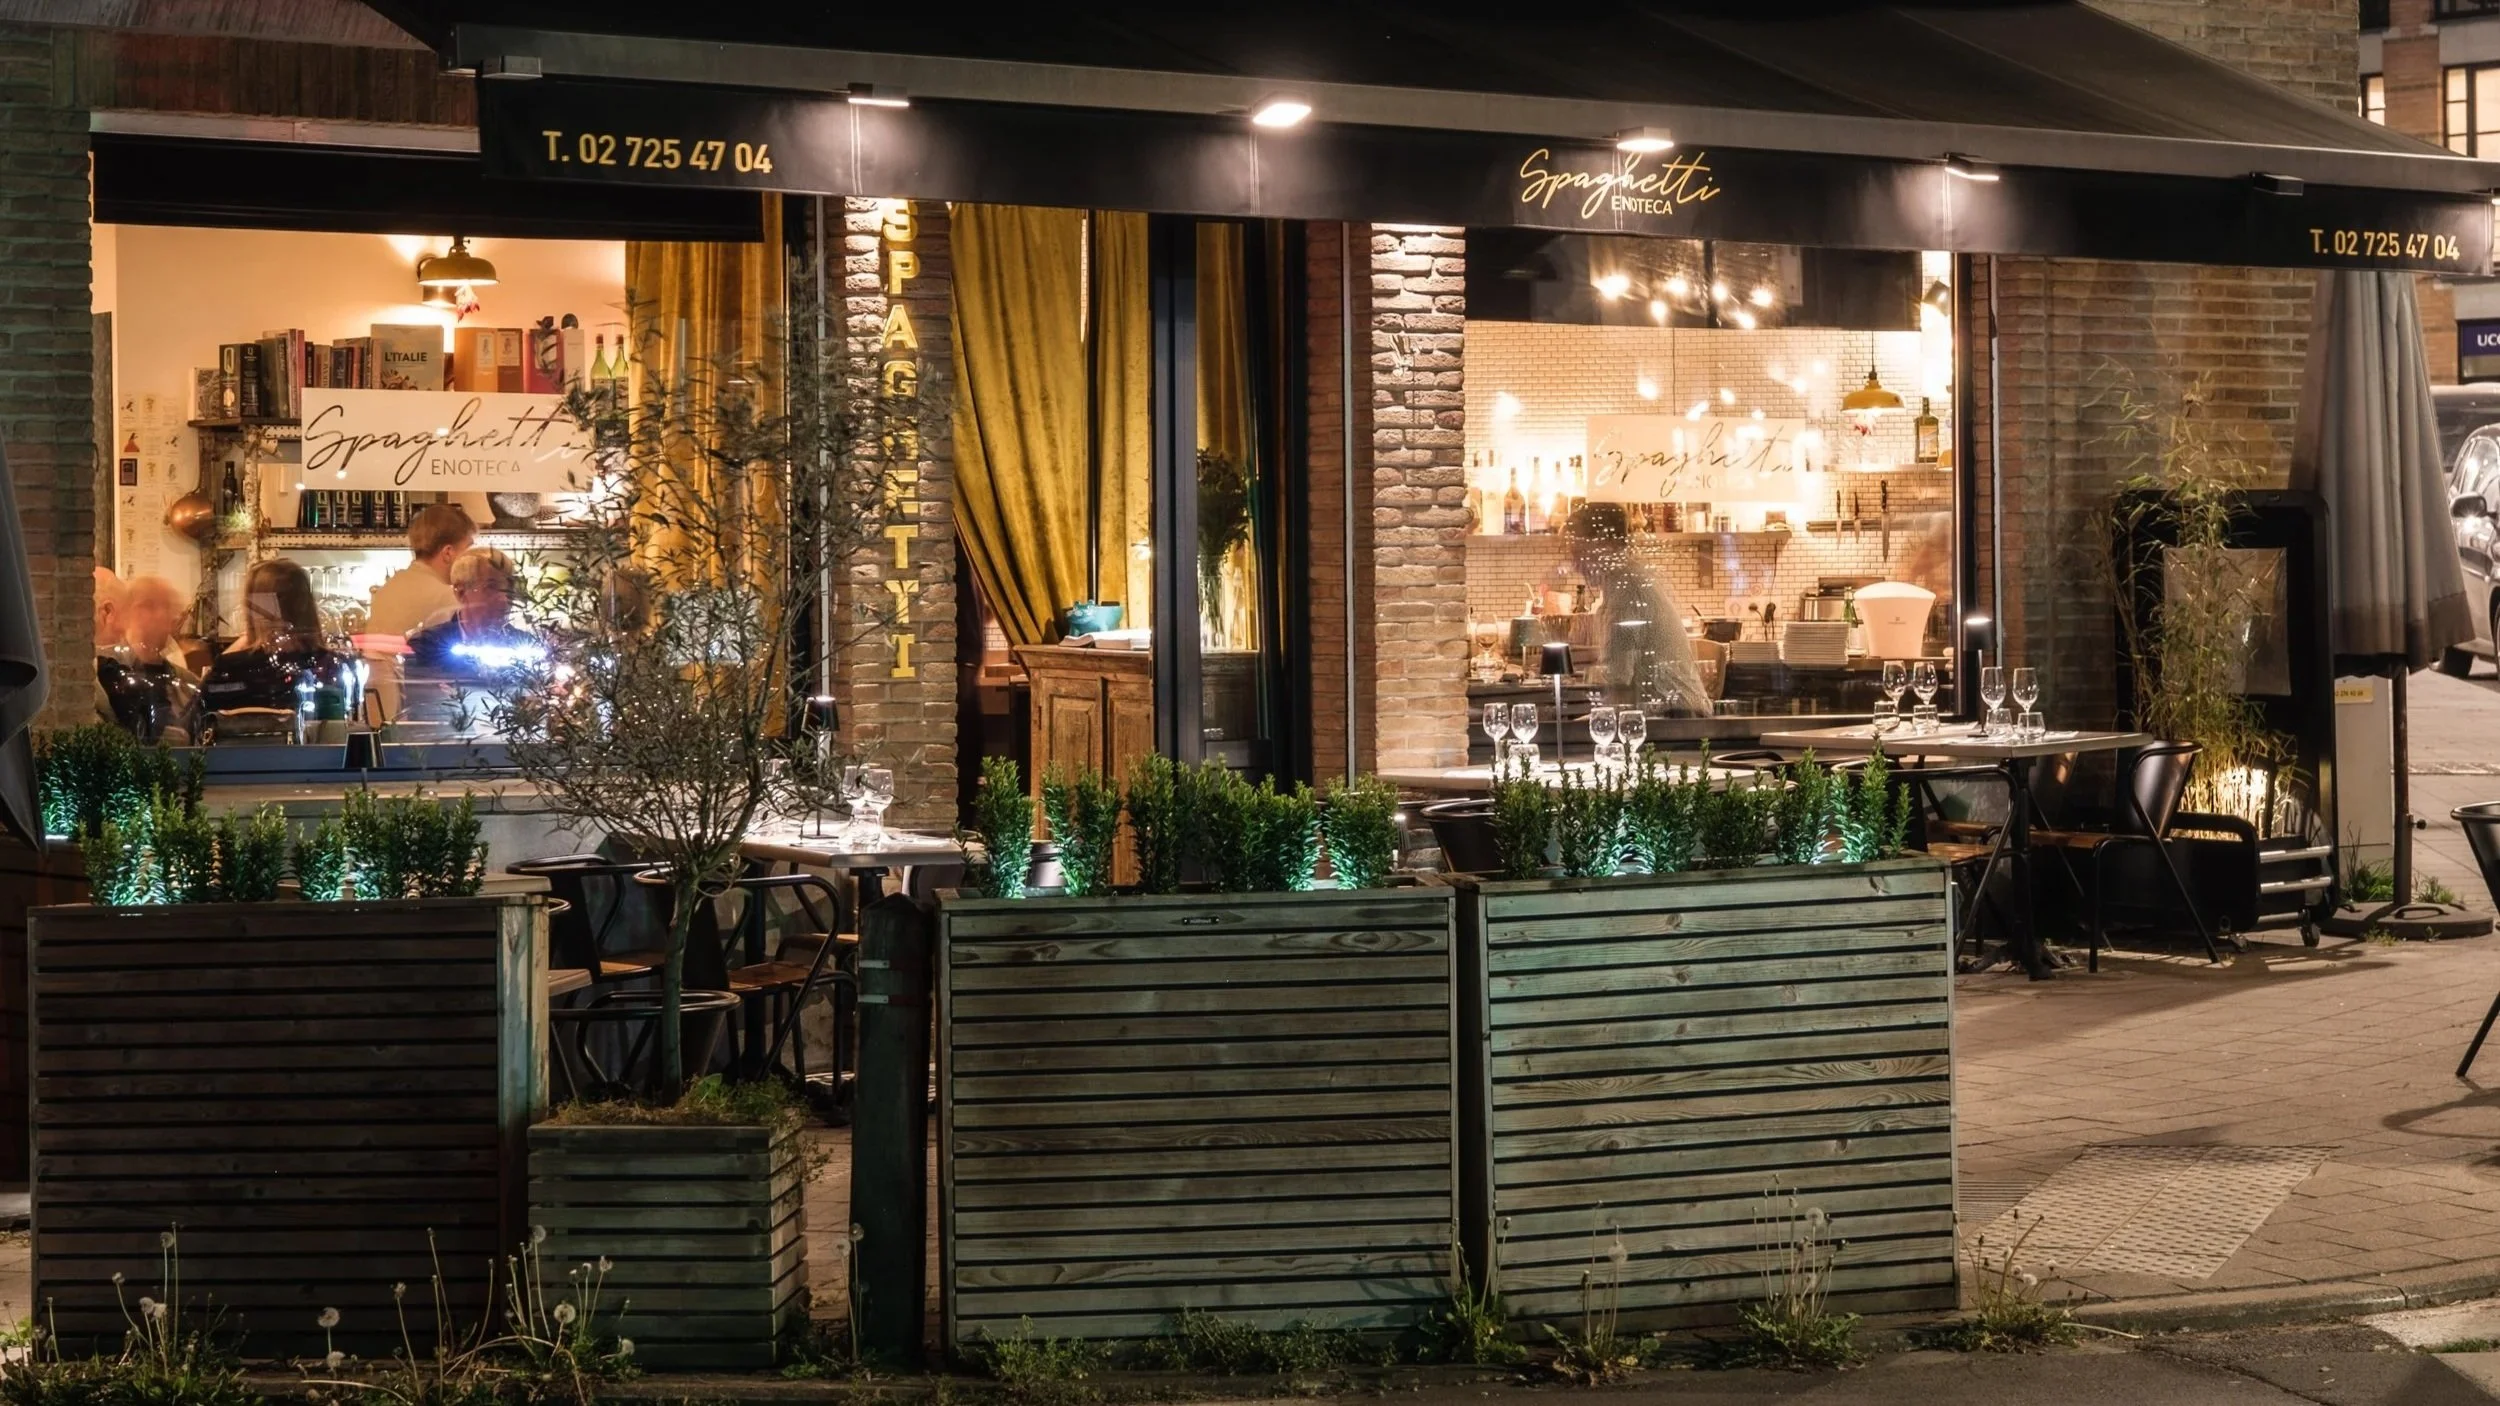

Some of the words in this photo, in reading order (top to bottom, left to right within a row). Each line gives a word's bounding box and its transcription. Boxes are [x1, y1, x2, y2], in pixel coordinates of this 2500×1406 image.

[542, 130, 569, 161] T.
[578, 133, 617, 165] 02
[625, 136, 682, 169] 725
[689, 140, 726, 171] 47
[734, 142, 773, 174] 04
[1520, 148, 1721, 219] Spaghetti
[1611, 195, 1673, 215] ENOTECA
[2310, 229, 2329, 254] T.
[2334, 230, 2359, 256] 02
[2364, 231, 2401, 257] 725
[2405, 233, 2429, 260] 47
[2434, 235, 2460, 261] 04
[384, 351, 428, 362] L'ITALIE
[304, 396, 588, 487] Spaghetti
[431, 458, 521, 476] ENOTECA
